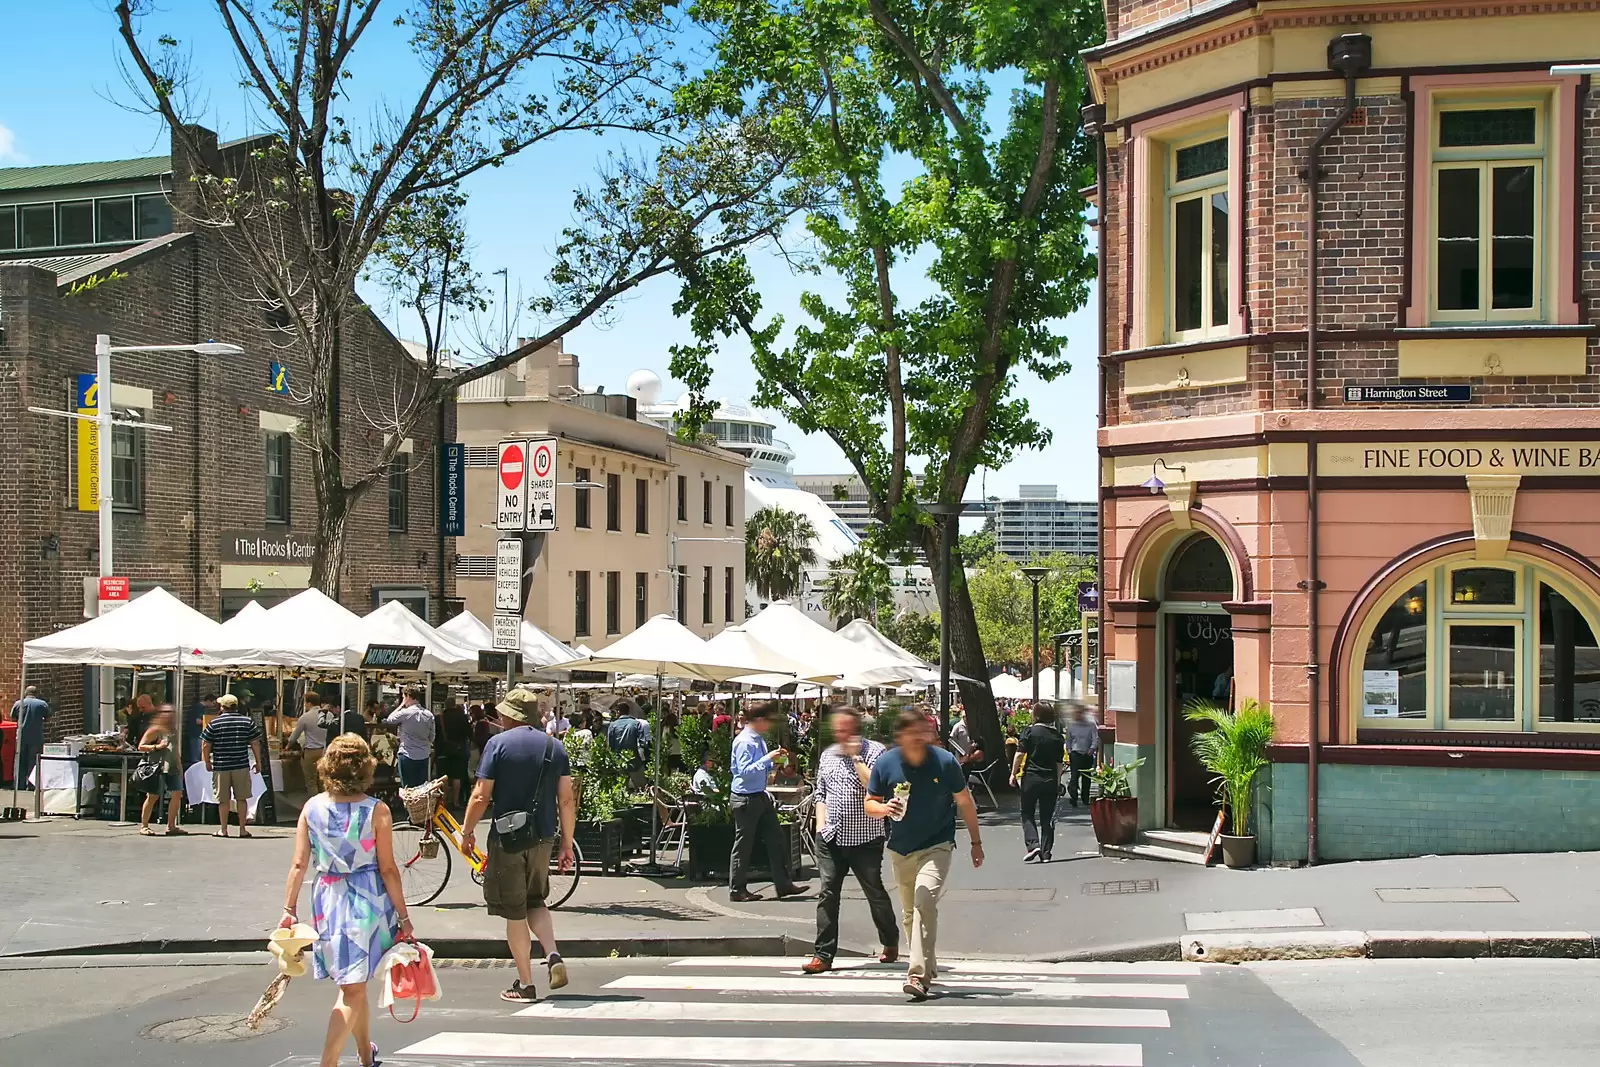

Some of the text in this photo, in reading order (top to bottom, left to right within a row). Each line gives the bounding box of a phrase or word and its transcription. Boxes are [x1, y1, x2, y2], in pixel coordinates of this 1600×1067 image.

[1365, 388, 1448, 399] Harrington Street
[88, 414, 99, 505] ydney Visitor Centre
[1363, 449, 1410, 468] FINE
[1417, 449, 1482, 468] FOOD
[1489, 449, 1504, 468] &
[1512, 448, 1570, 468] WINE
[448, 457, 458, 472] The
[448, 473, 458, 496] Rocks
[531, 479, 553, 489] SHARED
[534, 491, 549, 500] ZONE
[505, 495, 518, 508] NO
[448, 496, 458, 521] Centre
[500, 512, 522, 523] ENTRY
[240, 539, 256, 556] The
[261, 540, 286, 557] Rocks
[499, 556, 519, 565] DELIVERY
[499, 568, 519, 578] VEHICLES
[498, 580, 518, 589] EXCEPTED
[495, 618, 518, 627] EMERGENCY
[497, 628, 516, 637] VEHICLES
[1187, 622, 1231, 646] Odys
[497, 637, 516, 647] EXCEPTED
[365, 648, 397, 665] MUNICH
